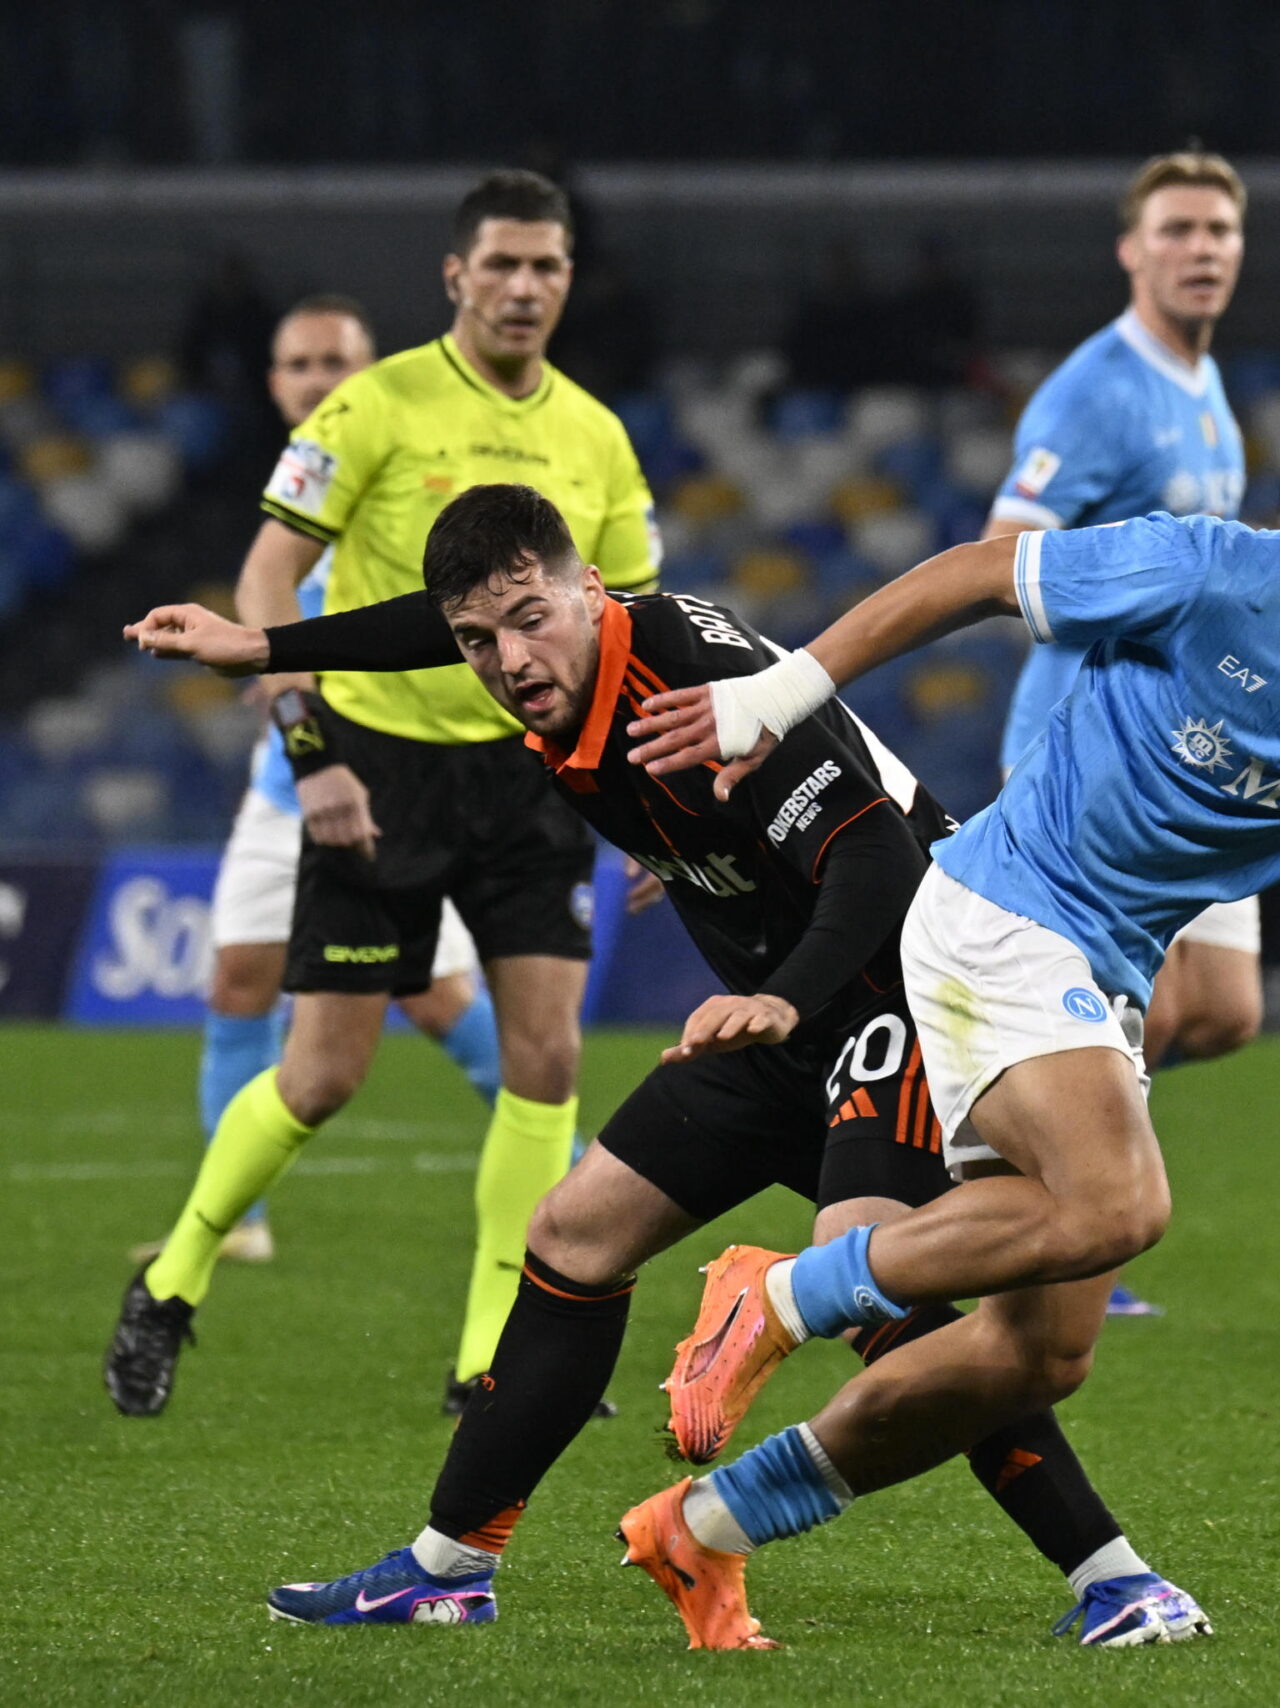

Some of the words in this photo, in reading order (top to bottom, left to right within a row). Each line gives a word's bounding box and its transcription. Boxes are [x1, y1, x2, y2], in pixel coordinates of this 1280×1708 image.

[670, 593, 754, 651] BAT
[1217, 654, 1268, 693] EA7
[767, 760, 842, 849] OKERSTARS
[795, 802, 823, 832] NEWS
